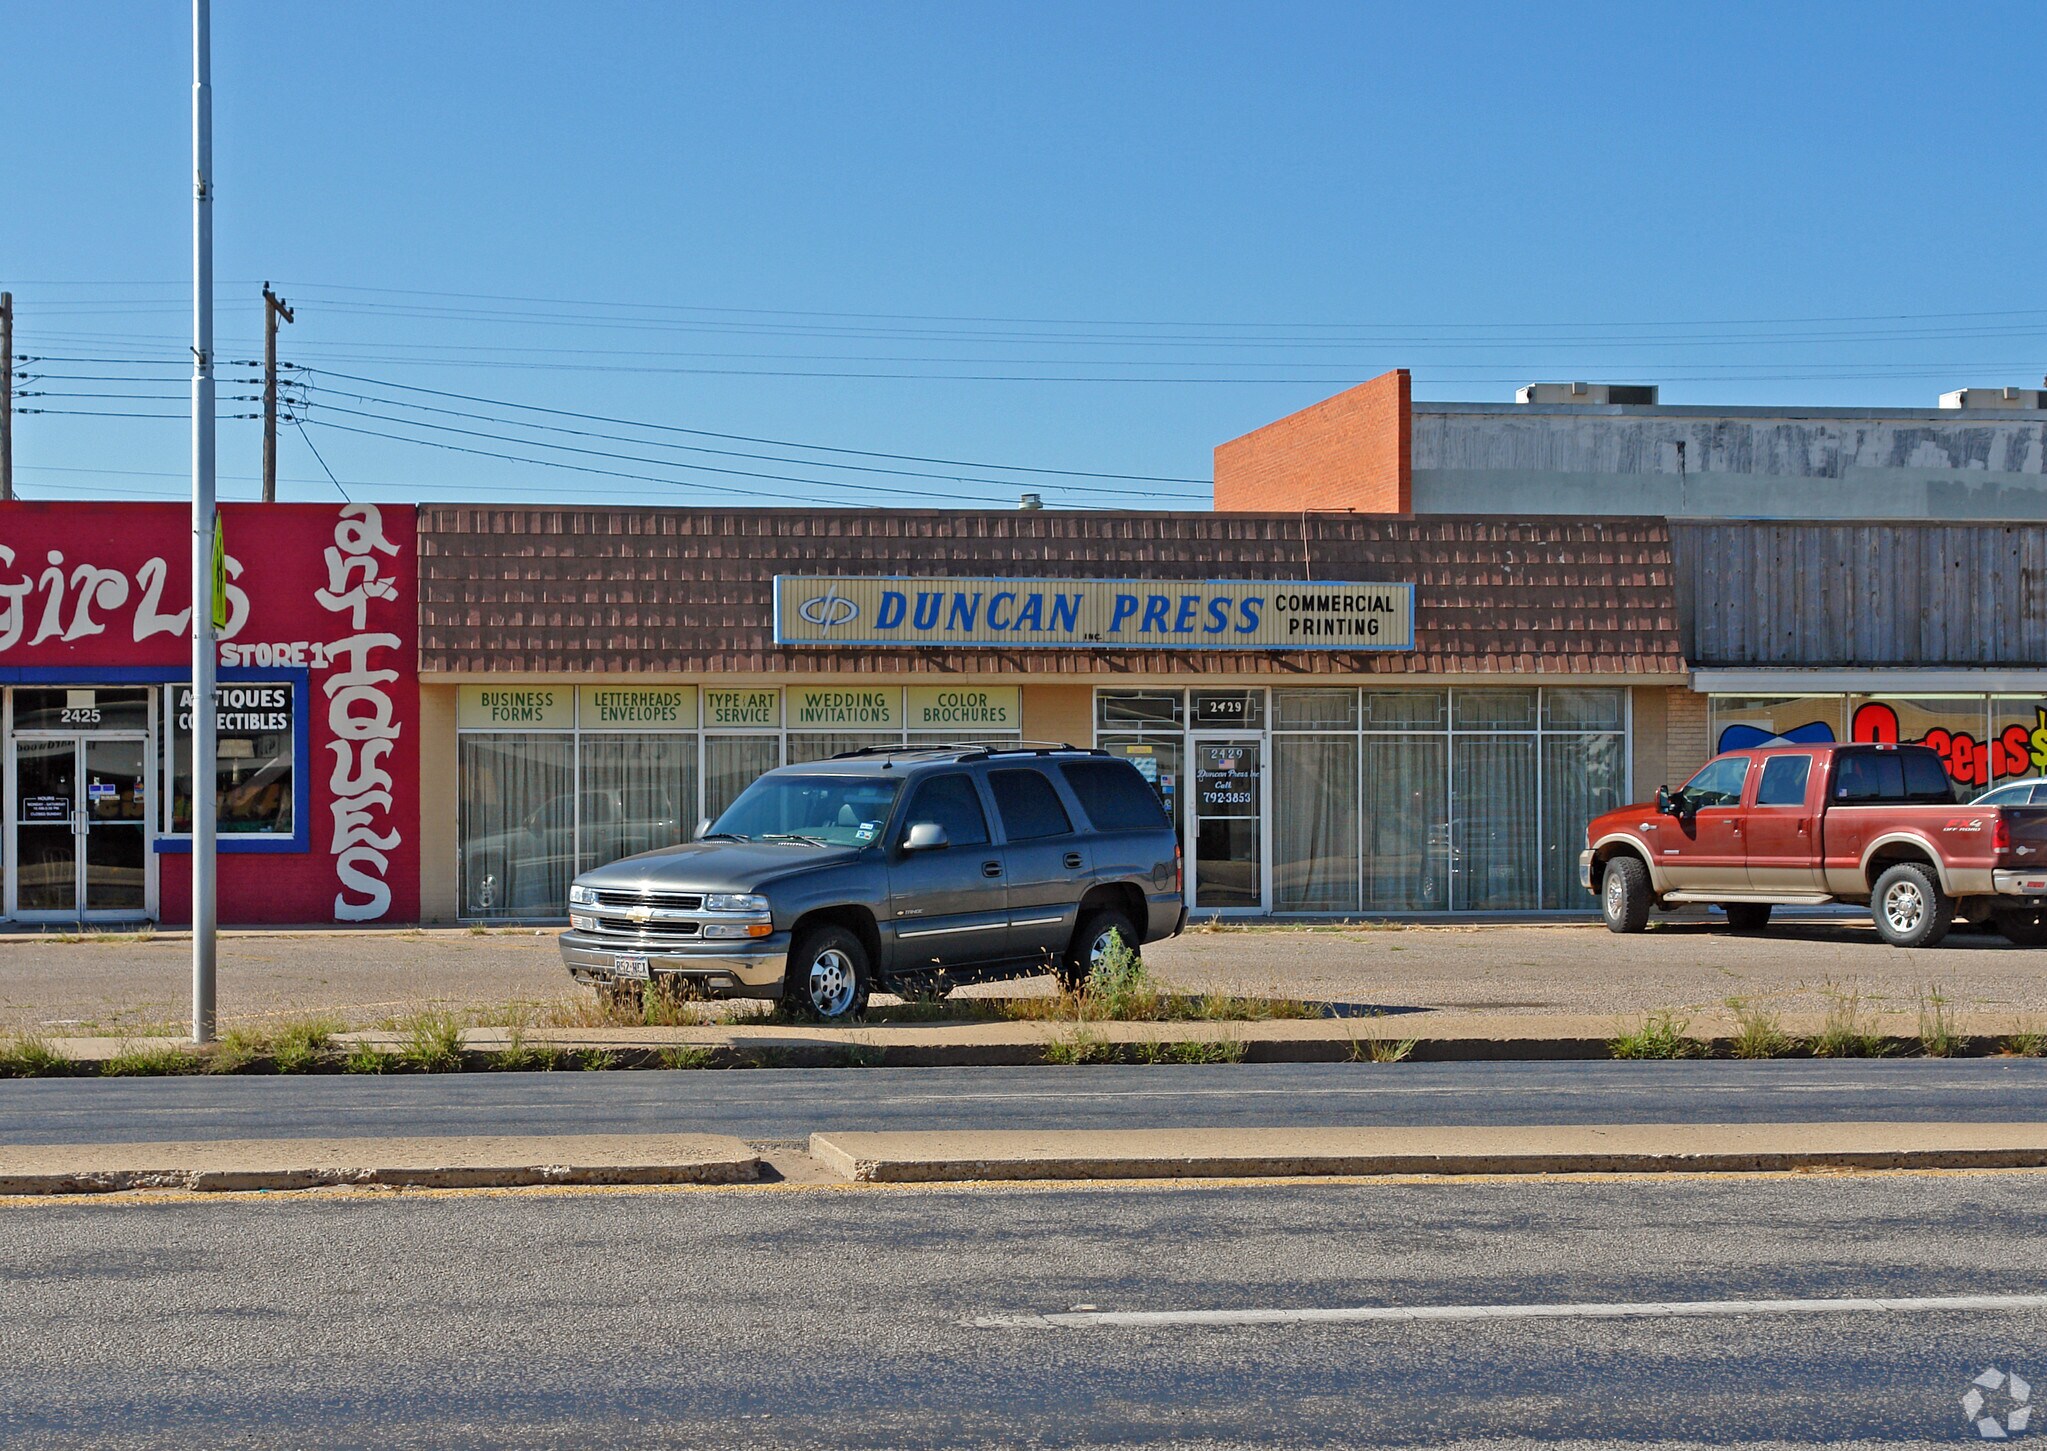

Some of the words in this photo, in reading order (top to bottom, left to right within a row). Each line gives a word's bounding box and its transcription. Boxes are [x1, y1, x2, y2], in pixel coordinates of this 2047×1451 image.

[1275, 594, 1394, 612] COMMERCIAL
[874, 591, 1084, 633] DUNCAN
[1107, 594, 1265, 634] PRESS
[1289, 618, 1379, 635] PRINTING
[179, 689, 285, 708] ATIQUES
[481, 692, 554, 707] BUSINESS
[594, 692, 682, 707] LETTERHEADS
[708, 693, 739, 707] TYPE
[748, 693, 774, 708] ART
[805, 693, 885, 708] WEDDING
[938, 693, 987, 708] COLOR
[492, 707, 543, 721] FORMS
[600, 707, 677, 721] ENVELOPES
[923, 707, 1007, 722] BROCHURES
[1210, 701, 1242, 713] 2429
[61, 709, 101, 723] 2425
[716, 708, 770, 722] SERVICE
[800, 708, 890, 722] INVITATIONS
[1211, 749, 1243, 759] 2429
